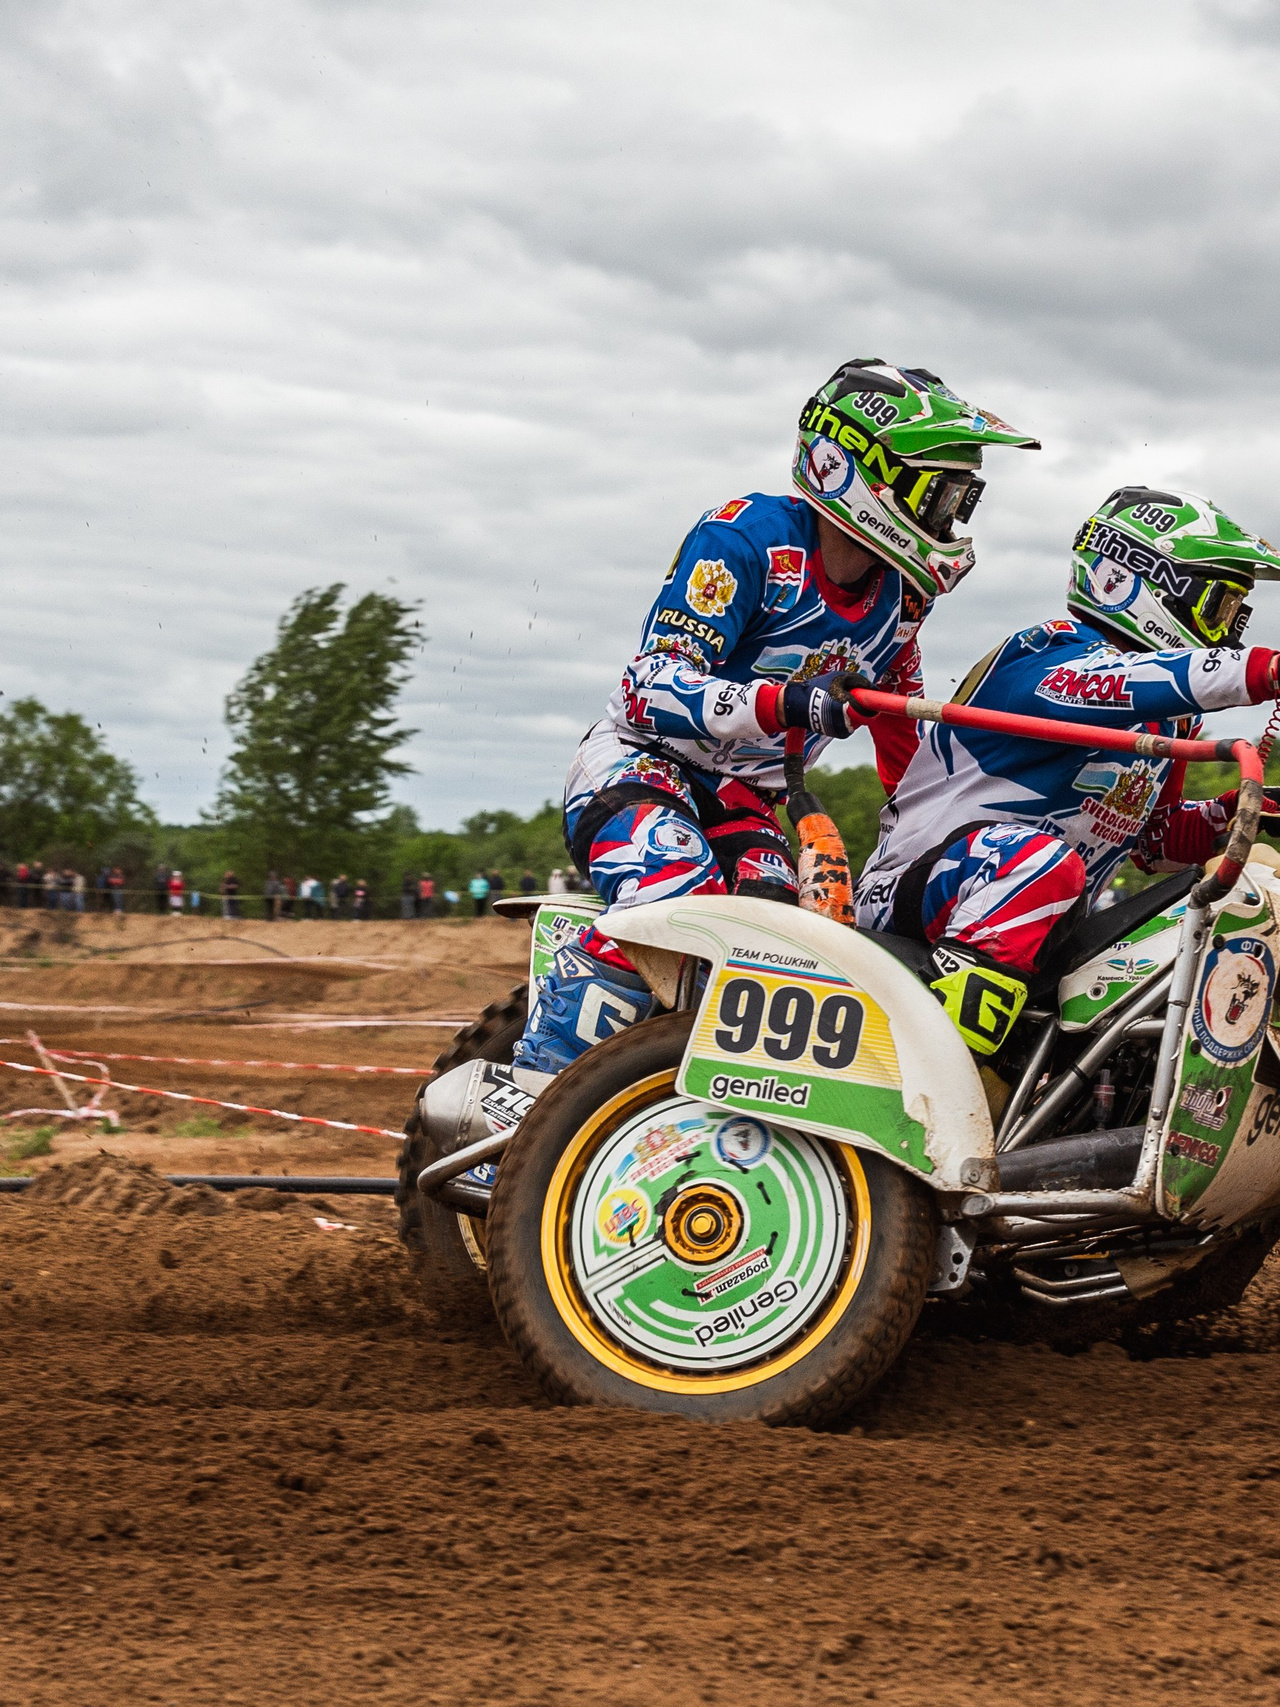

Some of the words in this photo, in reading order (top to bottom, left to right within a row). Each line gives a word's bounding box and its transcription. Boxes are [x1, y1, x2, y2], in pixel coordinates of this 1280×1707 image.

[854, 392, 898, 427] 999
[856, 509, 911, 550] geniled
[1131, 503, 1176, 533] 999
[657, 609, 726, 654] RUSSIA
[1143, 618, 1187, 648] genile
[1091, 824, 1127, 846] REGION
[731, 947, 761, 961] TEAM
[763, 952, 819, 970] POLUKHIN
[715, 978, 864, 1070] 999
[711, 1075, 809, 1105] geniled
[484, 1098, 520, 1120] EXHAUST
[695, 1281, 798, 1347] Geniled
